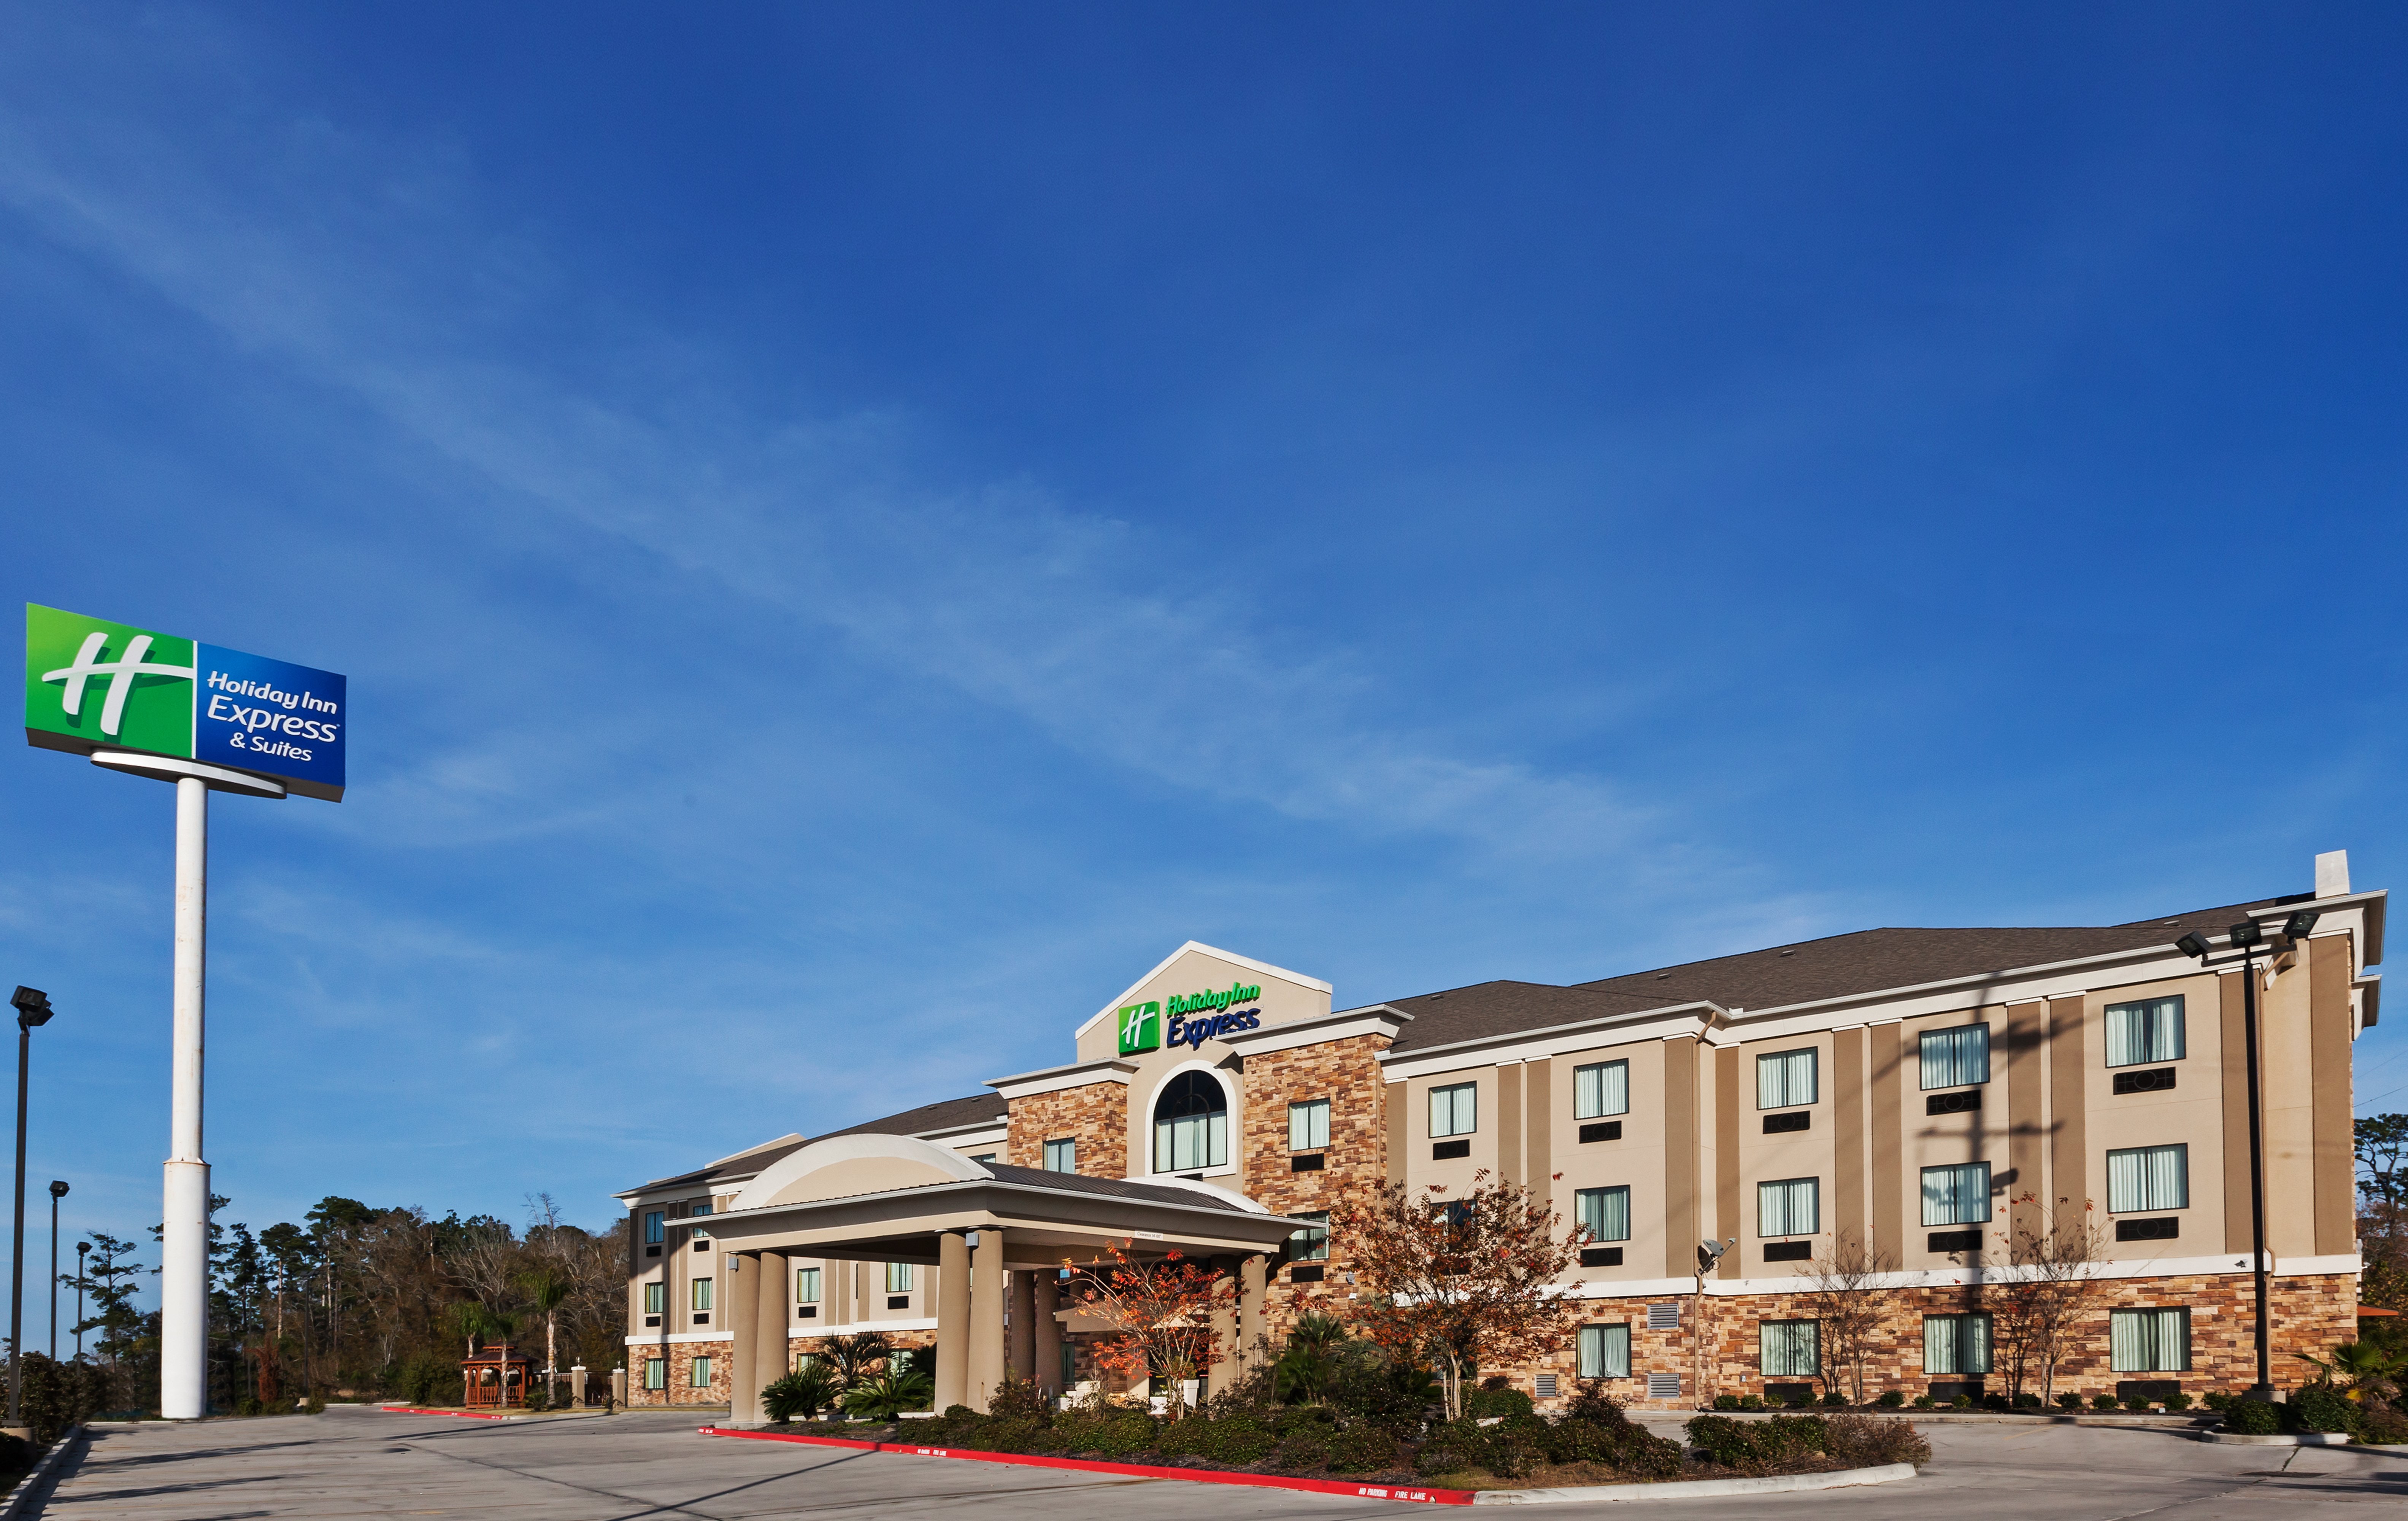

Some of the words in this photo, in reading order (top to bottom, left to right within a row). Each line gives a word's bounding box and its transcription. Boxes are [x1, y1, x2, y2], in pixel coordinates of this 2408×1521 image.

[207, 670, 299, 709] Holiday
[302, 691, 337, 714] Inn
[207, 694, 337, 742] Express
[230, 732, 246, 749] &
[250, 736, 313, 761] Suites
[1165, 989, 1232, 1016] Holiday
[1230, 981, 1261, 1002] Inn
[1166, 1008, 1261, 1051] Express
[1367, 1488, 1388, 1497] PARKING
[1395, 1491, 1408, 1499] FIRE
[1410, 1492, 1426, 1500] LANE
